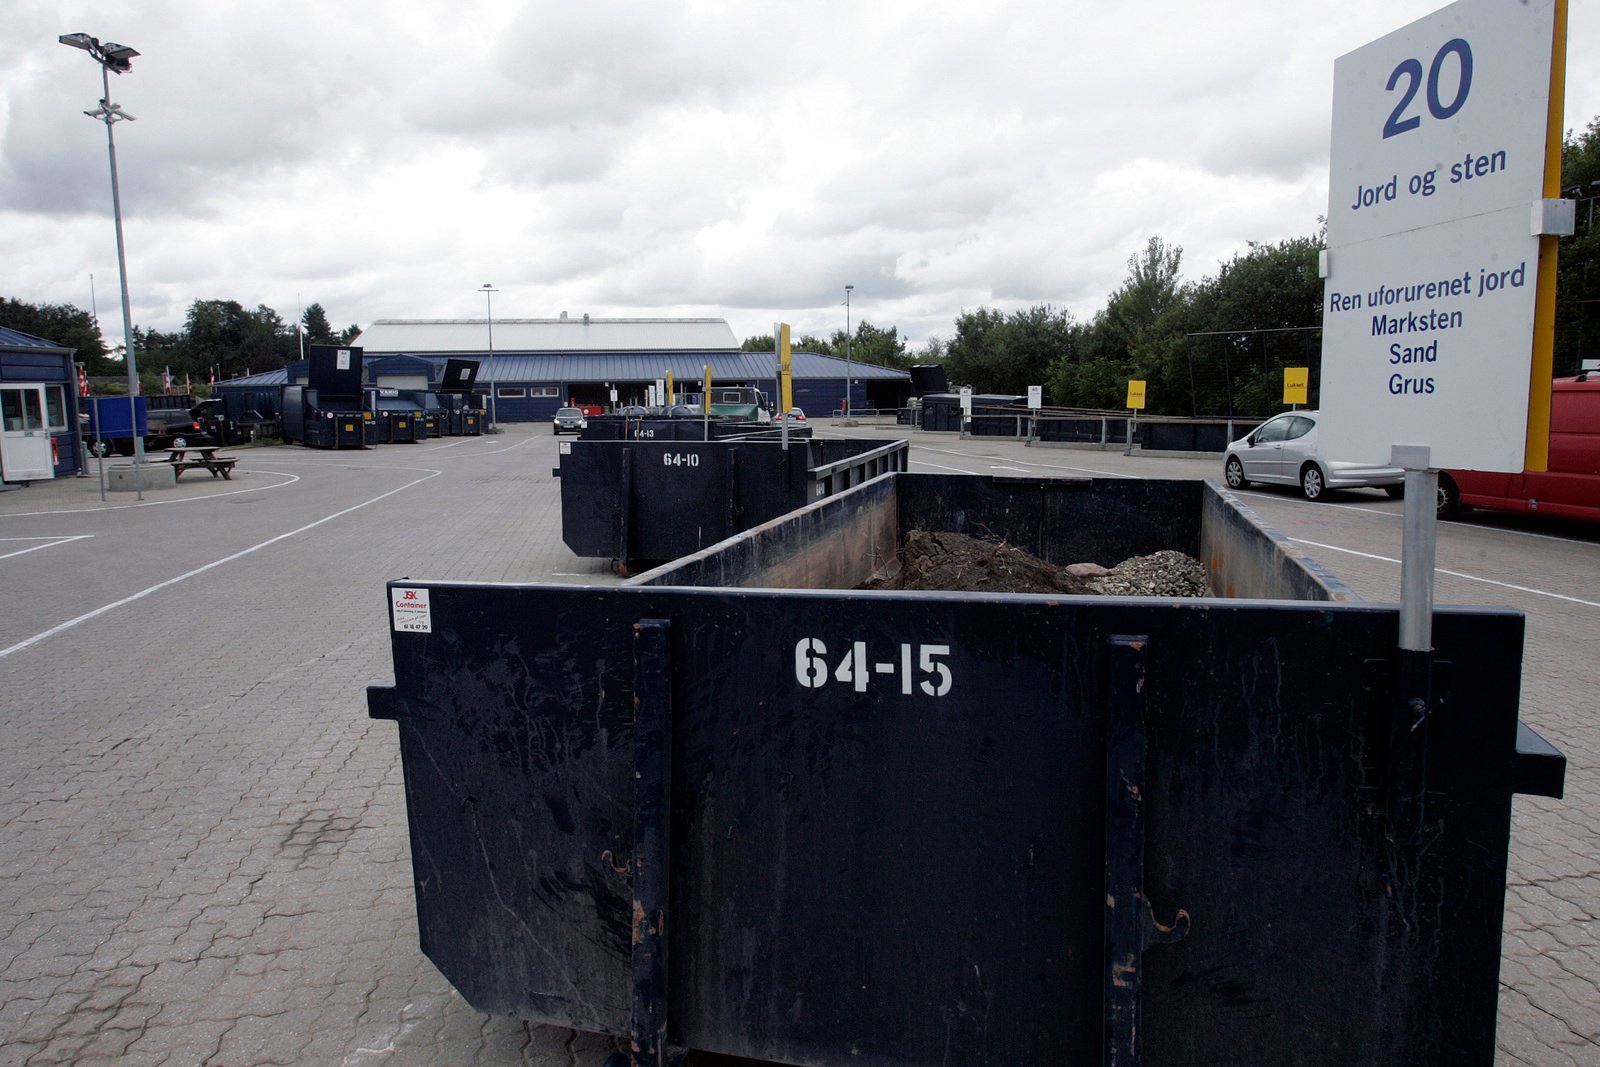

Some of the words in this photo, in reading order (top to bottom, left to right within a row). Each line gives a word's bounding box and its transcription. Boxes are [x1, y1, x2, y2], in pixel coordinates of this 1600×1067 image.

[1383, 38, 1473, 140] 20
[1352, 175, 1397, 210] Jord
[1409, 169, 1437, 197] og
[1450, 150, 1506, 184] sten
[1330, 292, 1362, 313] Ren
[1368, 271, 1472, 308] uforurenet
[1478, 262, 1526, 297] jord
[1371, 309, 1463, 336] Marksten
[1389, 340, 1438, 365] Sand
[1388, 373, 1435, 395] Grus
[663, 452, 699, 467] 64-10
[403, 591, 418, 599] JSK
[795, 637, 953, 697] 64-15
